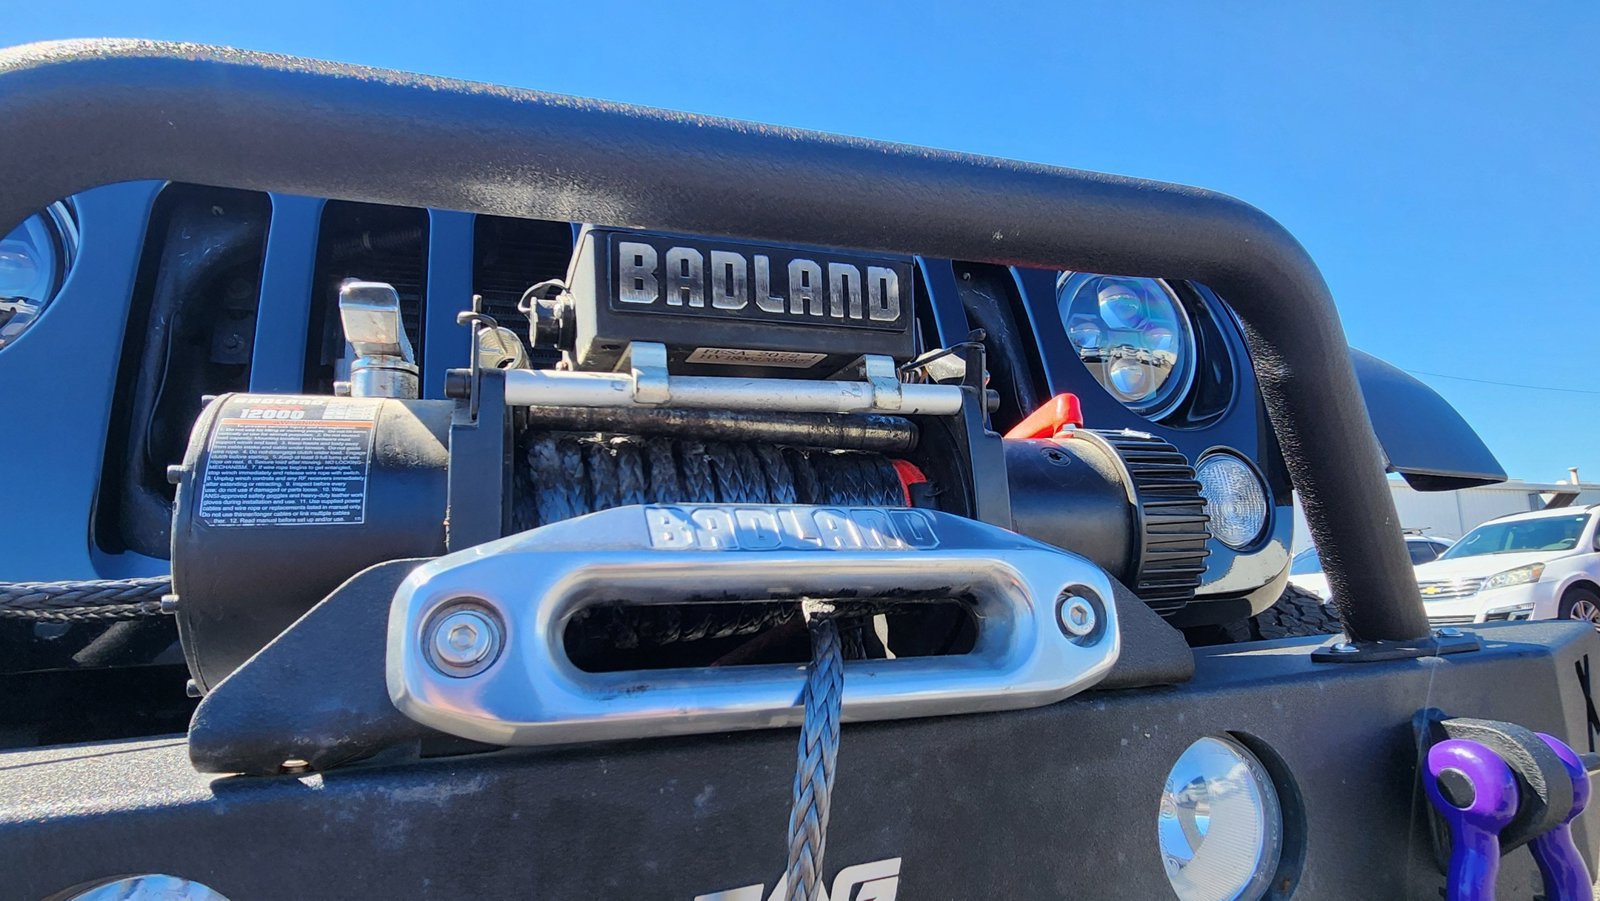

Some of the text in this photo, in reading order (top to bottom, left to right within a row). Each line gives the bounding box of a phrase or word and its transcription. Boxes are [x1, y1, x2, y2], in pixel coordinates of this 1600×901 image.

[618, 240, 901, 323] BADLAND
[240, 408, 305, 419] 12000
[644, 506, 941, 551] BADLAND
